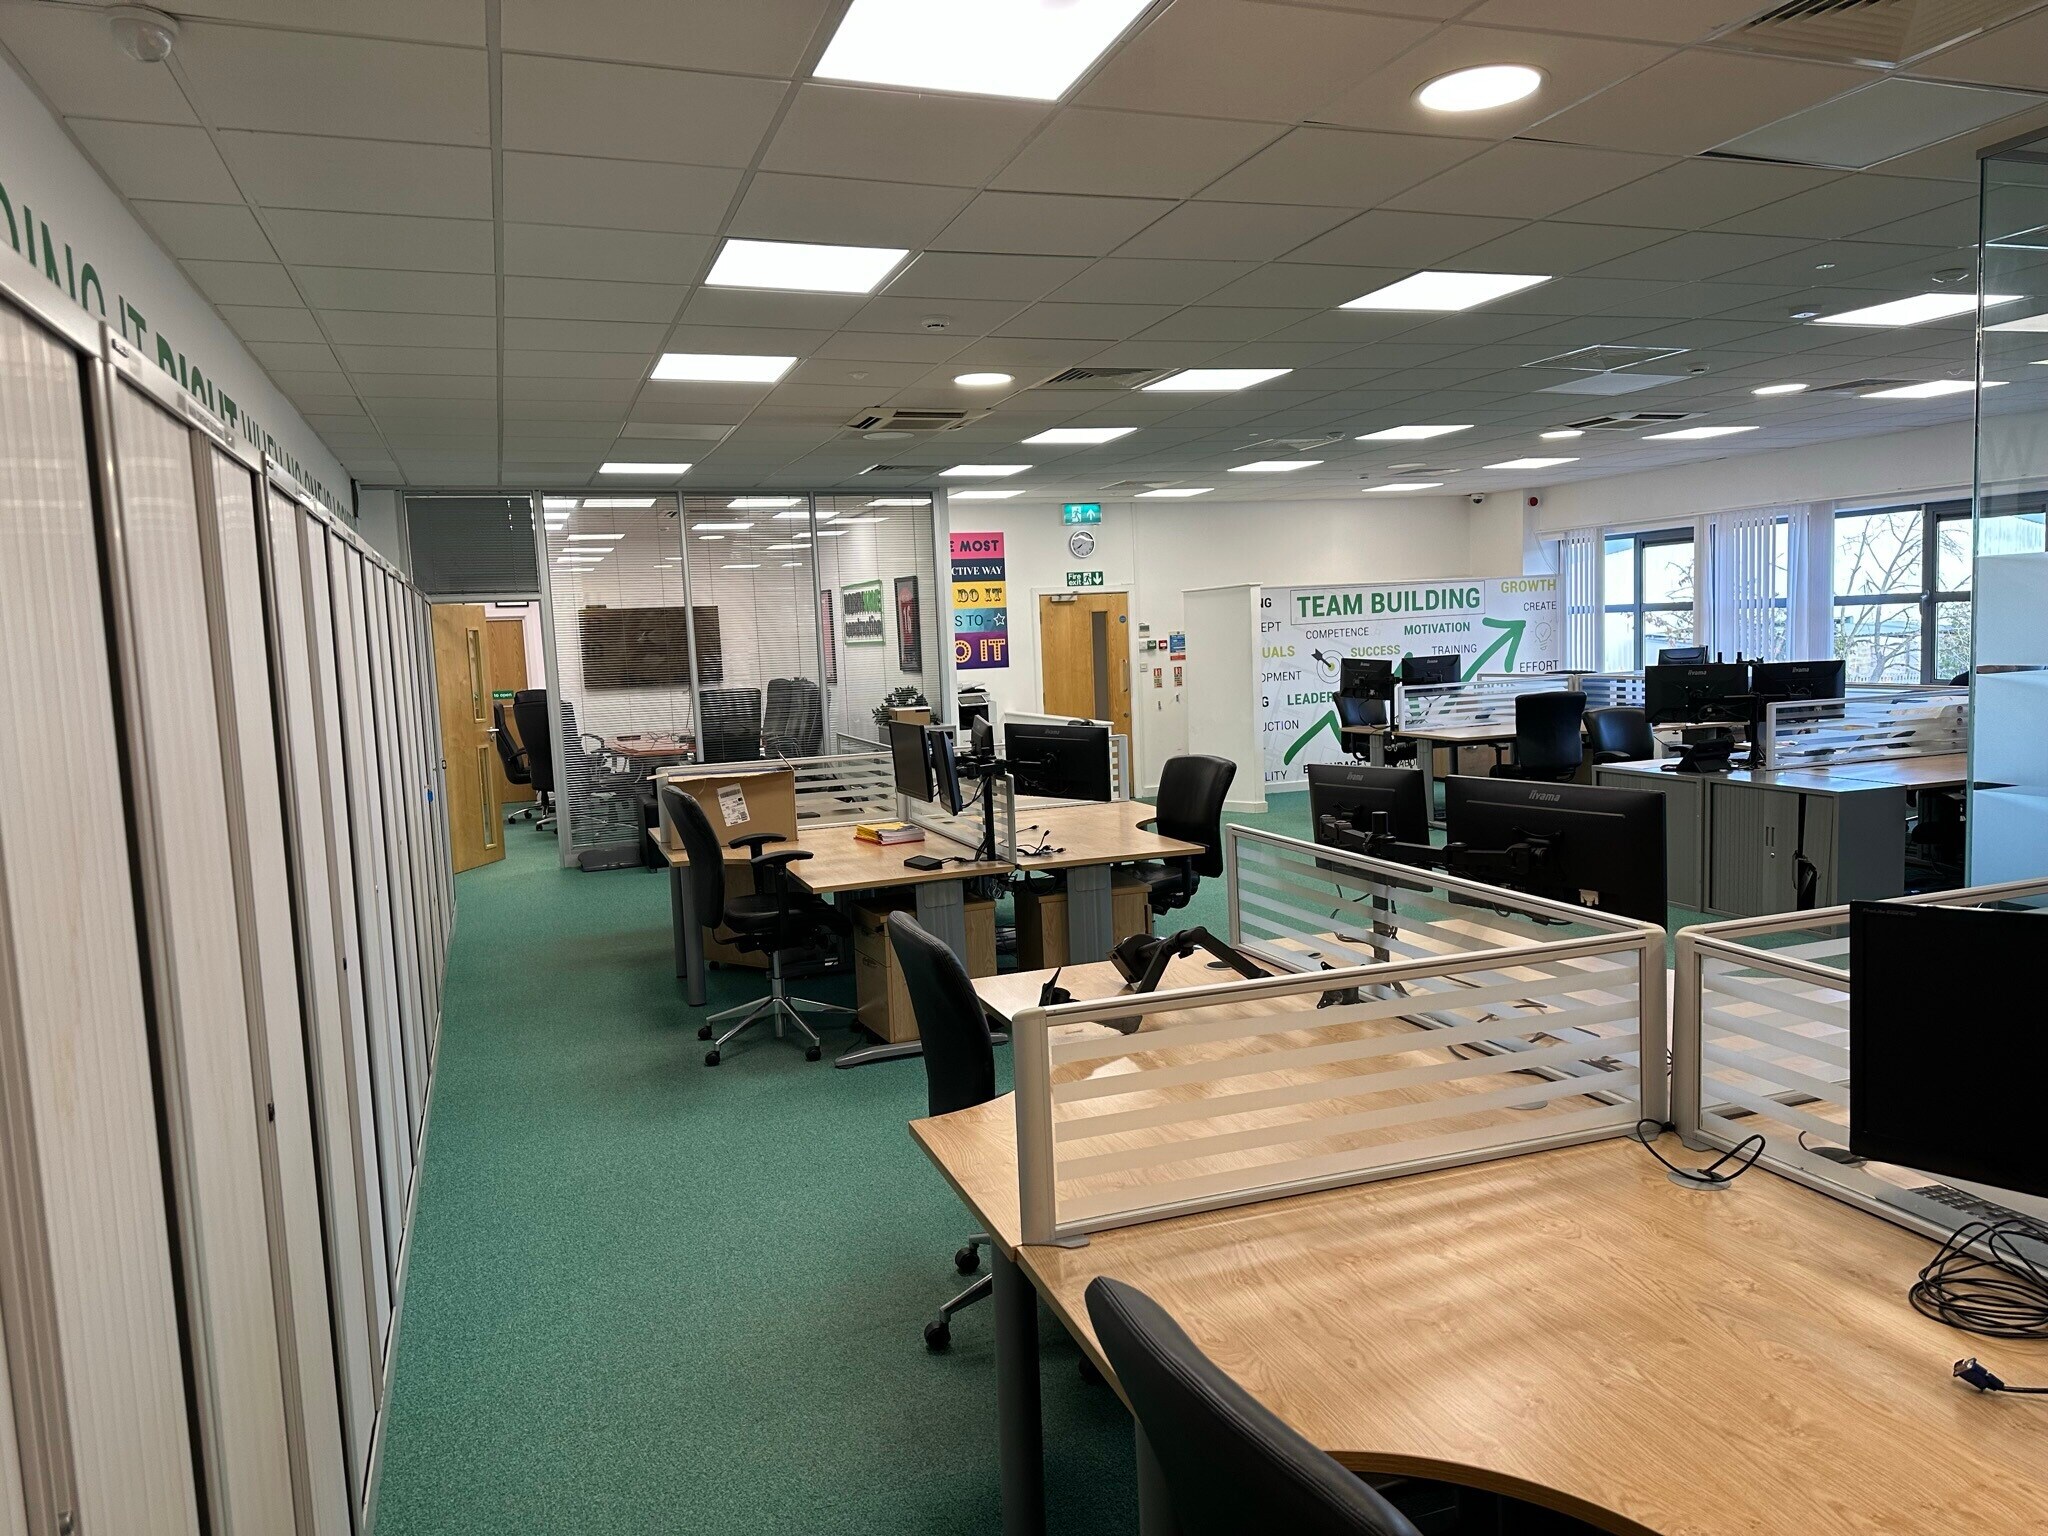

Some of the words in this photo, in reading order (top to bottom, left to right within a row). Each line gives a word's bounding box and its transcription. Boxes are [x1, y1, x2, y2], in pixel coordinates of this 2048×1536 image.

[960, 540, 999, 552] MOST
[981, 565, 1003, 575] WAY
[1501, 578, 1557, 593] GROWTH
[957, 588, 980, 603] DO
[984, 587, 1003, 602] IT
[1297, 593, 1363, 618] TEAM
[1371, 587, 1480, 614] BUILDING
[1523, 601, 1557, 611] CREATE
[966, 614, 984, 627] TO
[1261, 621, 1281, 633] EPT
[1305, 627, 1369, 640] COMPETENCE
[1404, 621, 1471, 635] MOTIVATION
[980, 638, 1006, 662] IT
[1262, 645, 1295, 659] UALS
[1350, 644, 1401, 658] SUCCESS
[1432, 643, 1477, 655] TRAINING
[1519, 660, 1559, 673] EFFORT
[1287, 691, 1335, 706] LEADER
